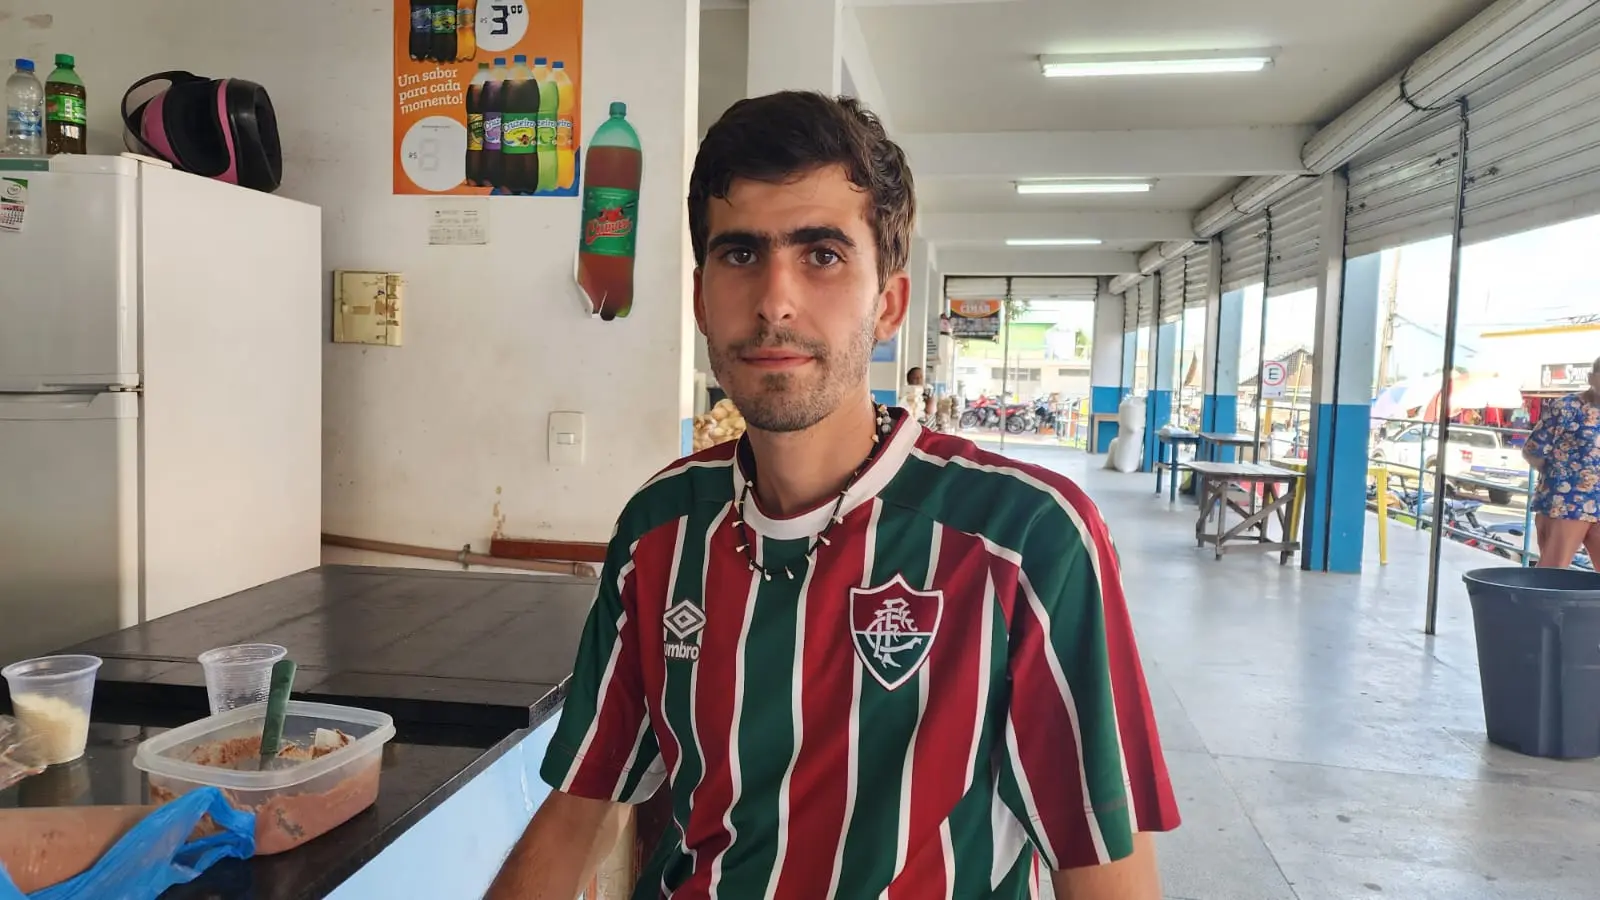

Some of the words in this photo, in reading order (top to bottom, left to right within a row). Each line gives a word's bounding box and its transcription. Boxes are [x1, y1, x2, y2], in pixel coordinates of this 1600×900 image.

[398, 73, 420, 87] Um
[422, 67, 458, 81] sabor
[398, 86, 428, 104] para
[430, 80, 461, 93] cada
[400, 93, 463, 114] momento!
[502, 118, 536, 132] Cruzeiro
[1268, 367, 1280, 380] E
